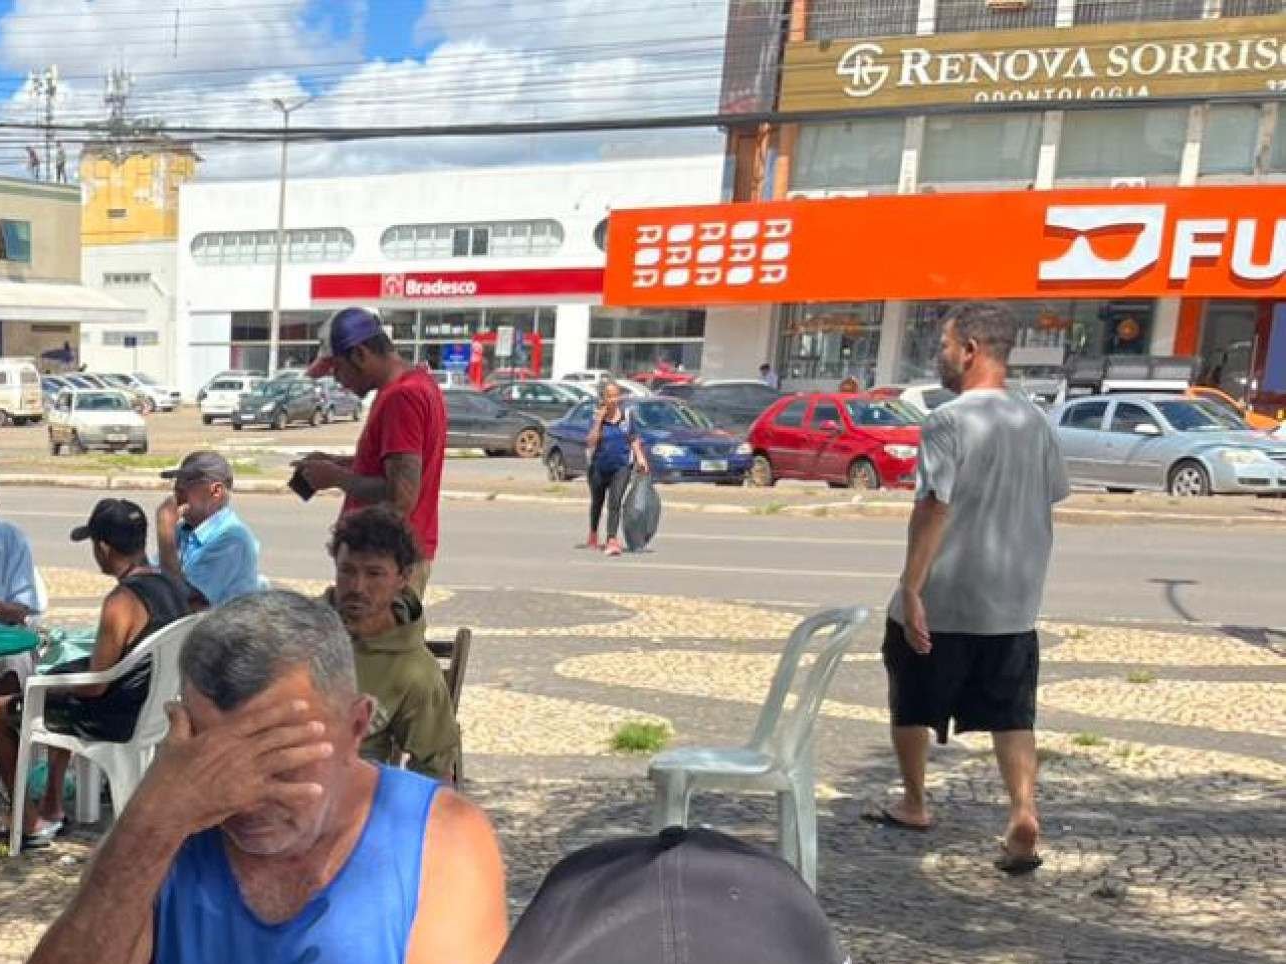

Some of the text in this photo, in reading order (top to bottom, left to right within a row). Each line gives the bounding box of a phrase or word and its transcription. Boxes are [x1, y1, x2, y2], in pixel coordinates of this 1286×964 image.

[897, 37, 1286, 87] RENOVA SORRIS
[406, 279, 477, 296] Bradesco
